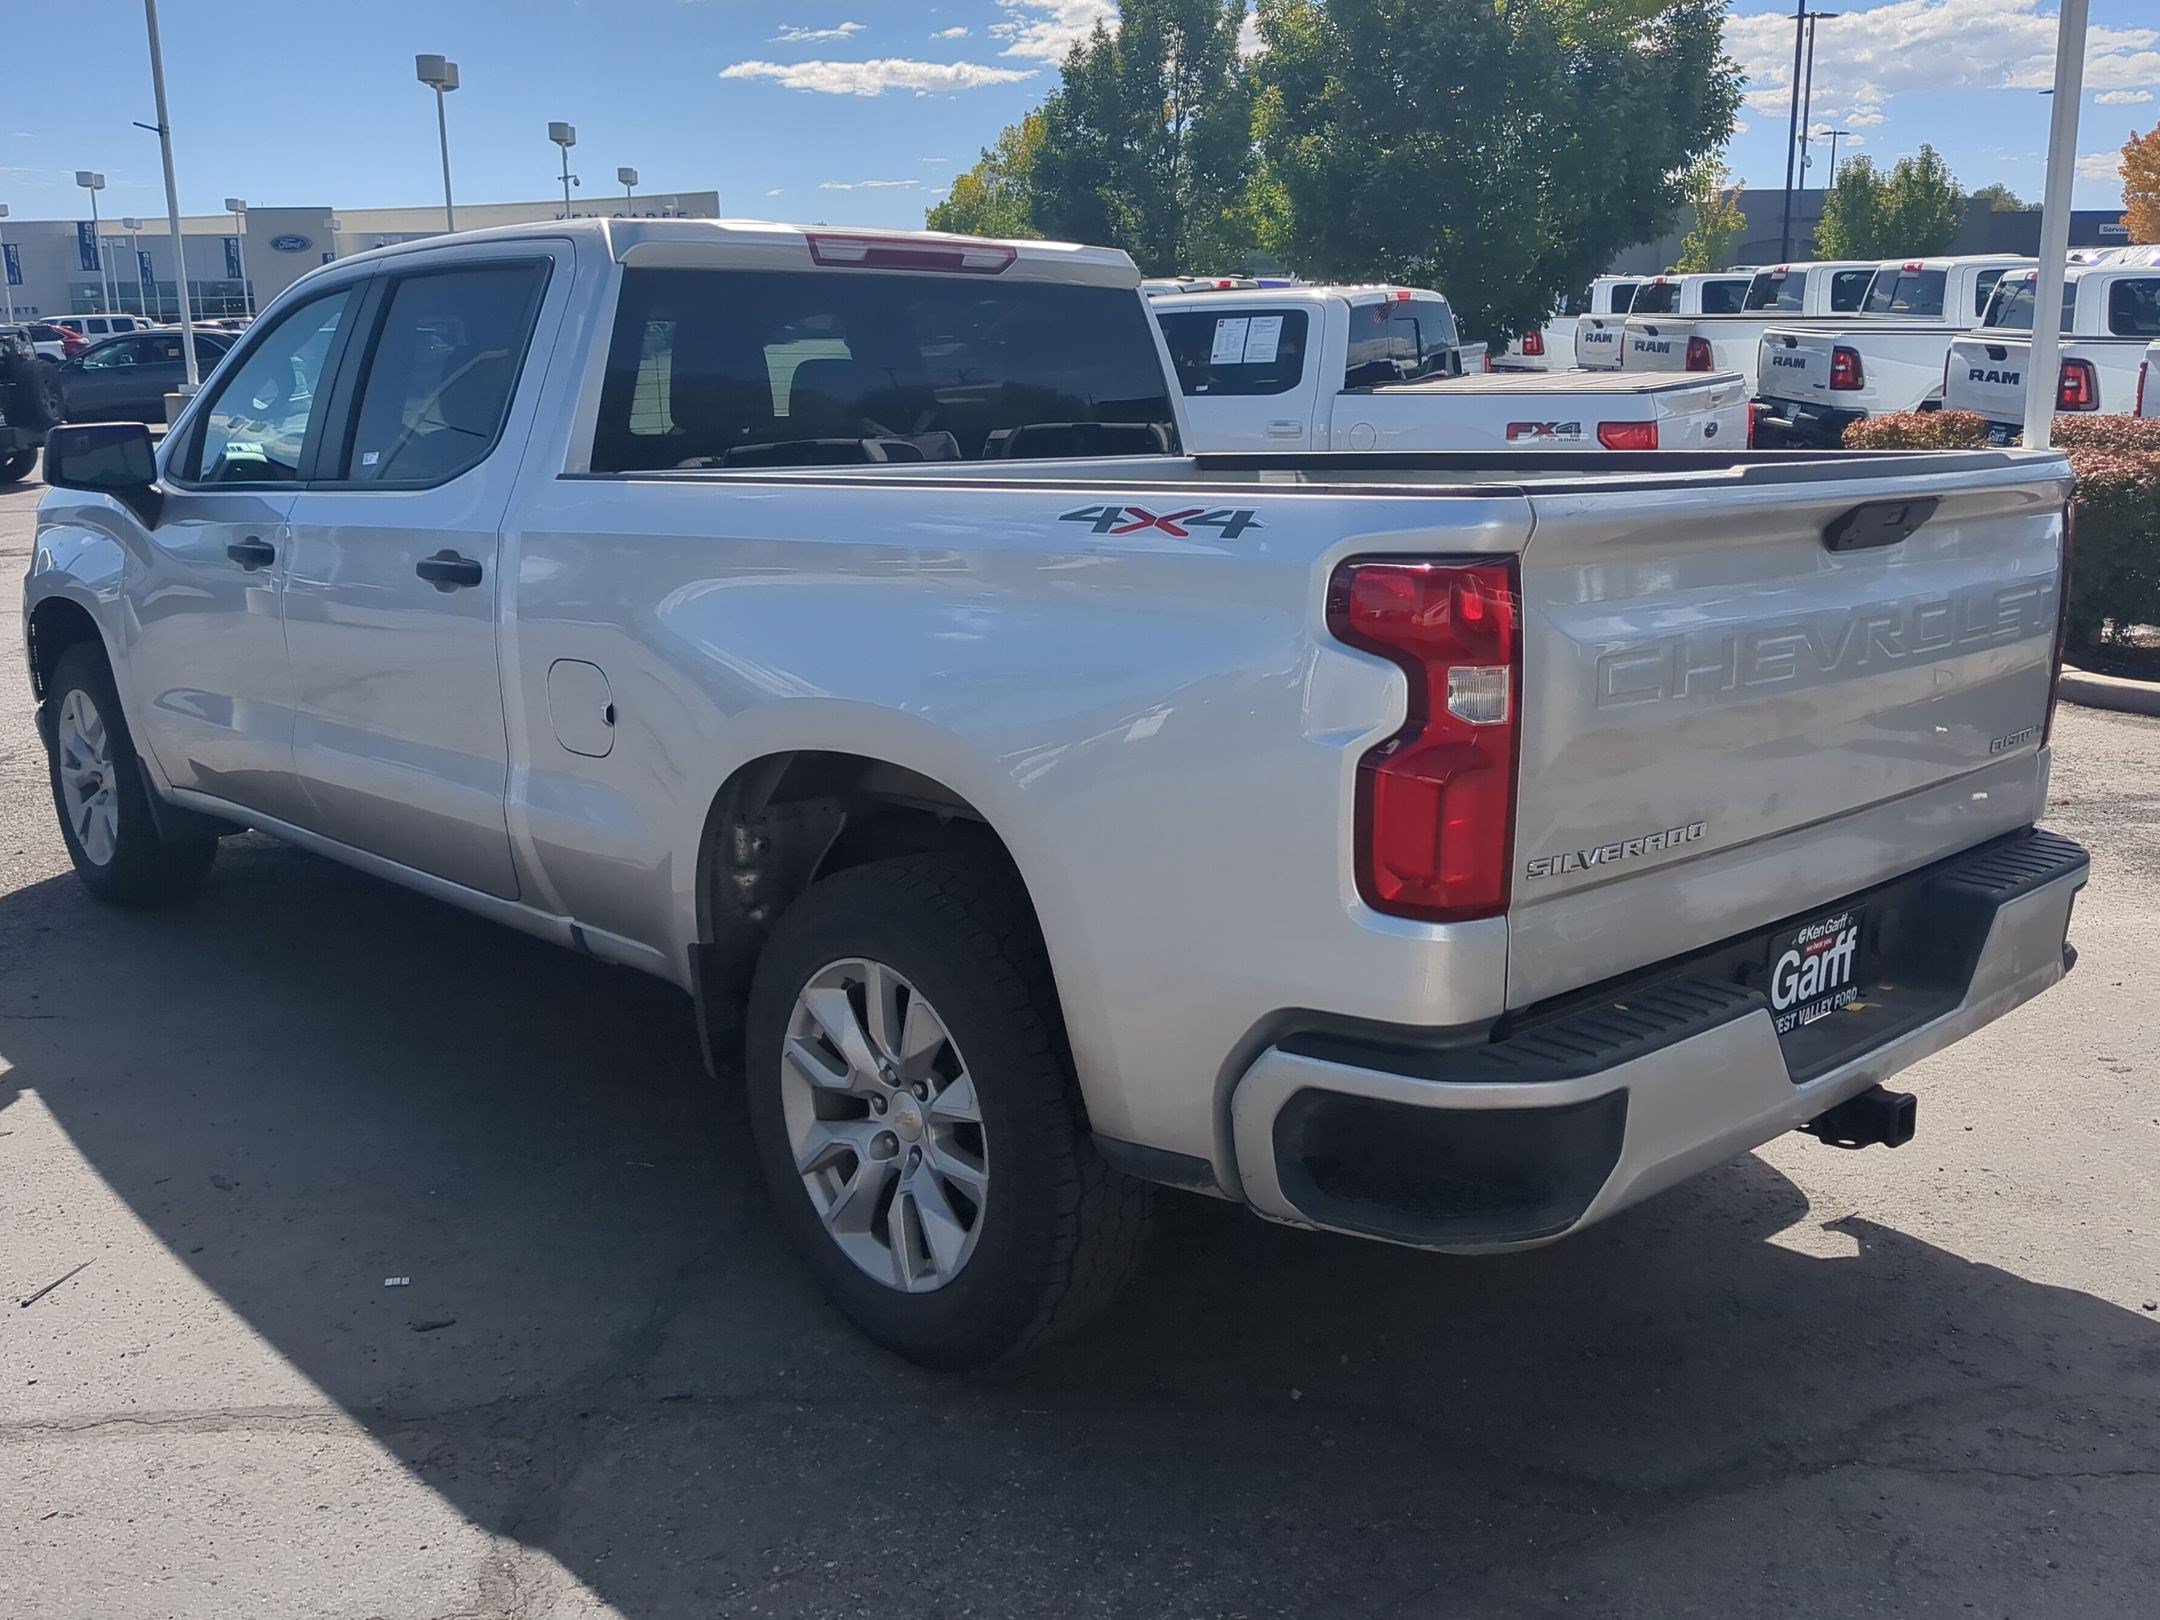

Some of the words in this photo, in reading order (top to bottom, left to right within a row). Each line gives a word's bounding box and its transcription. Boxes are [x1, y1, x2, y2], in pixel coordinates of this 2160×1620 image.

[278, 238, 304, 249] Ford
[1585, 333, 1613, 343] RAM
[1635, 341, 1671, 353] RAM
[1773, 356, 1806, 369] RAM
[1969, 368, 2020, 385] RAM
[1506, 422, 1581, 440] FX4
[1594, 582, 2053, 709] CHEVROLET
[1526, 821, 1707, 880] SILVERADO
[1806, 925, 1825, 943] Ken
[1825, 913, 1848, 935] Garff
[1771, 926, 1858, 1011] Garff
[1777, 1012, 1797, 1034] EST
[1799, 996, 1834, 1025] VALLEY
[1834, 986, 1858, 1010] FORD
